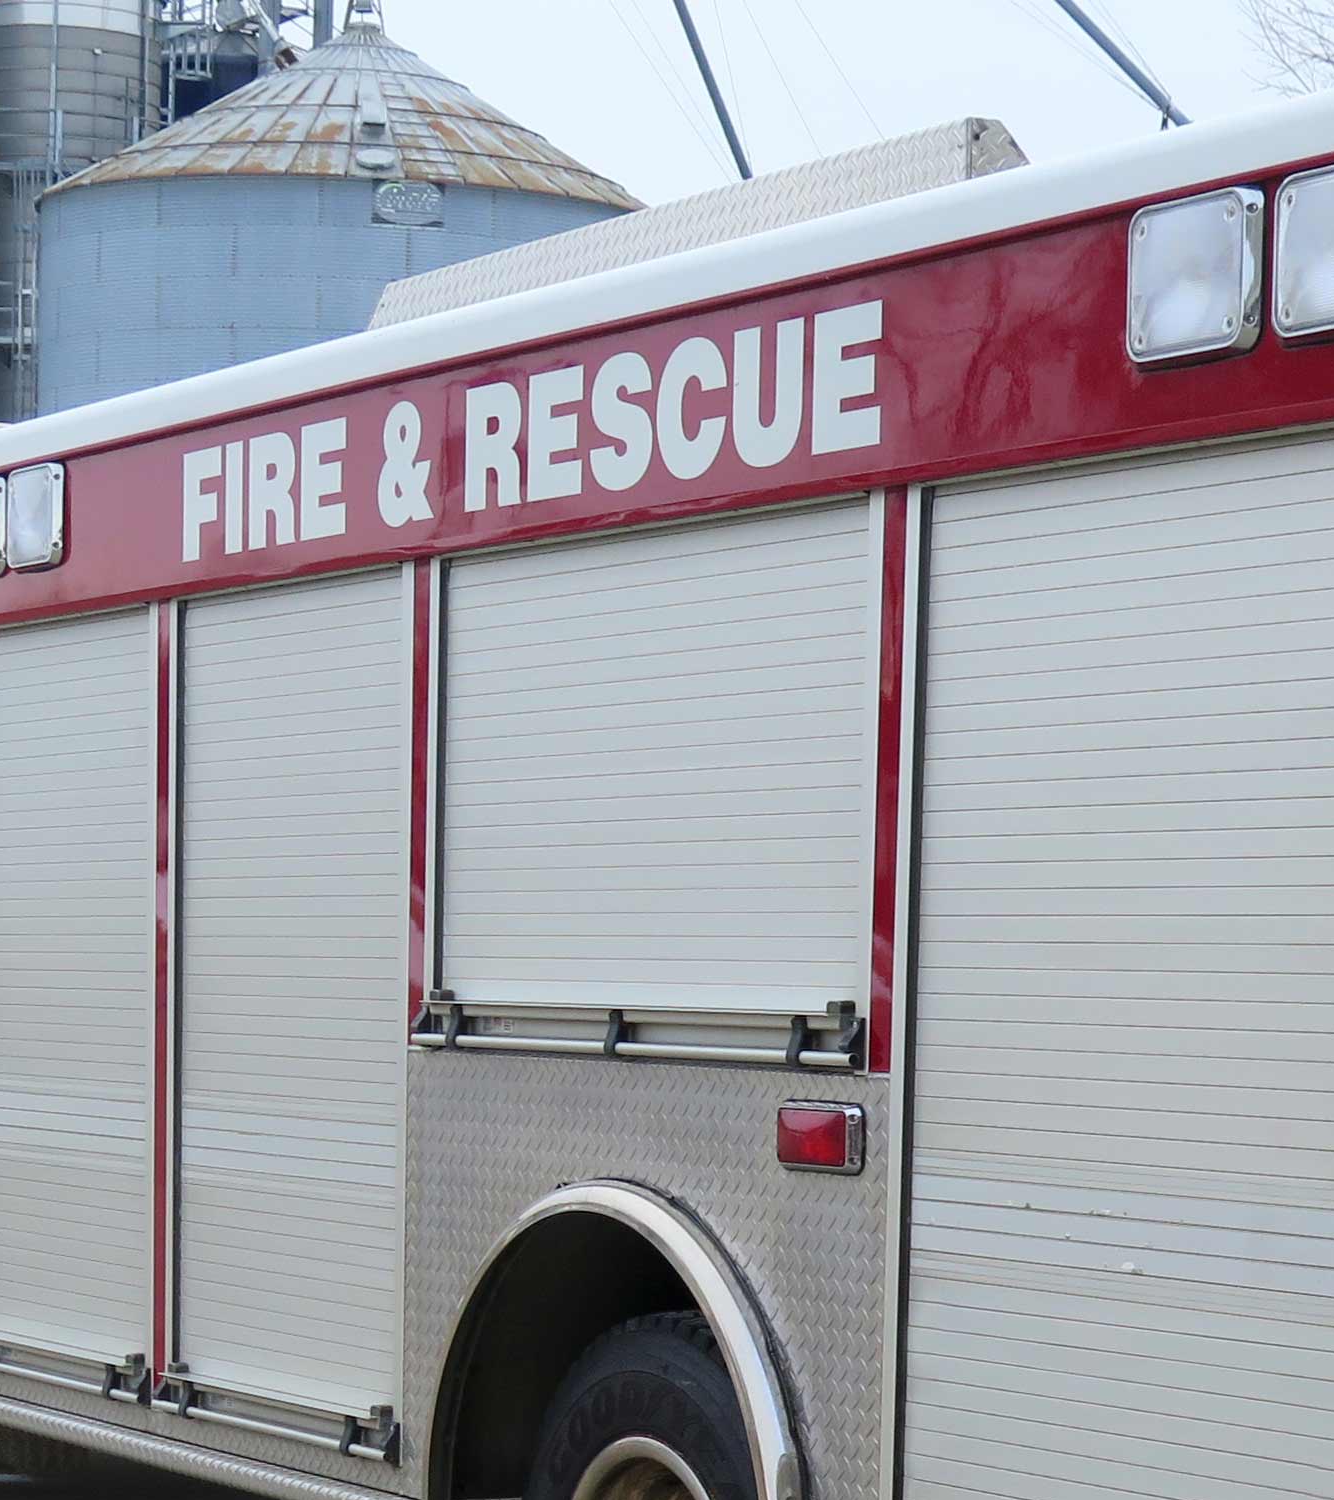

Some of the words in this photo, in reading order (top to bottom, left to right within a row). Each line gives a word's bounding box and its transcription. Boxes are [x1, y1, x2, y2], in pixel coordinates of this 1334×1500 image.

[183, 416, 348, 563] FIRE
[377, 400, 434, 528] &
[464, 299, 884, 513] RESCUE
